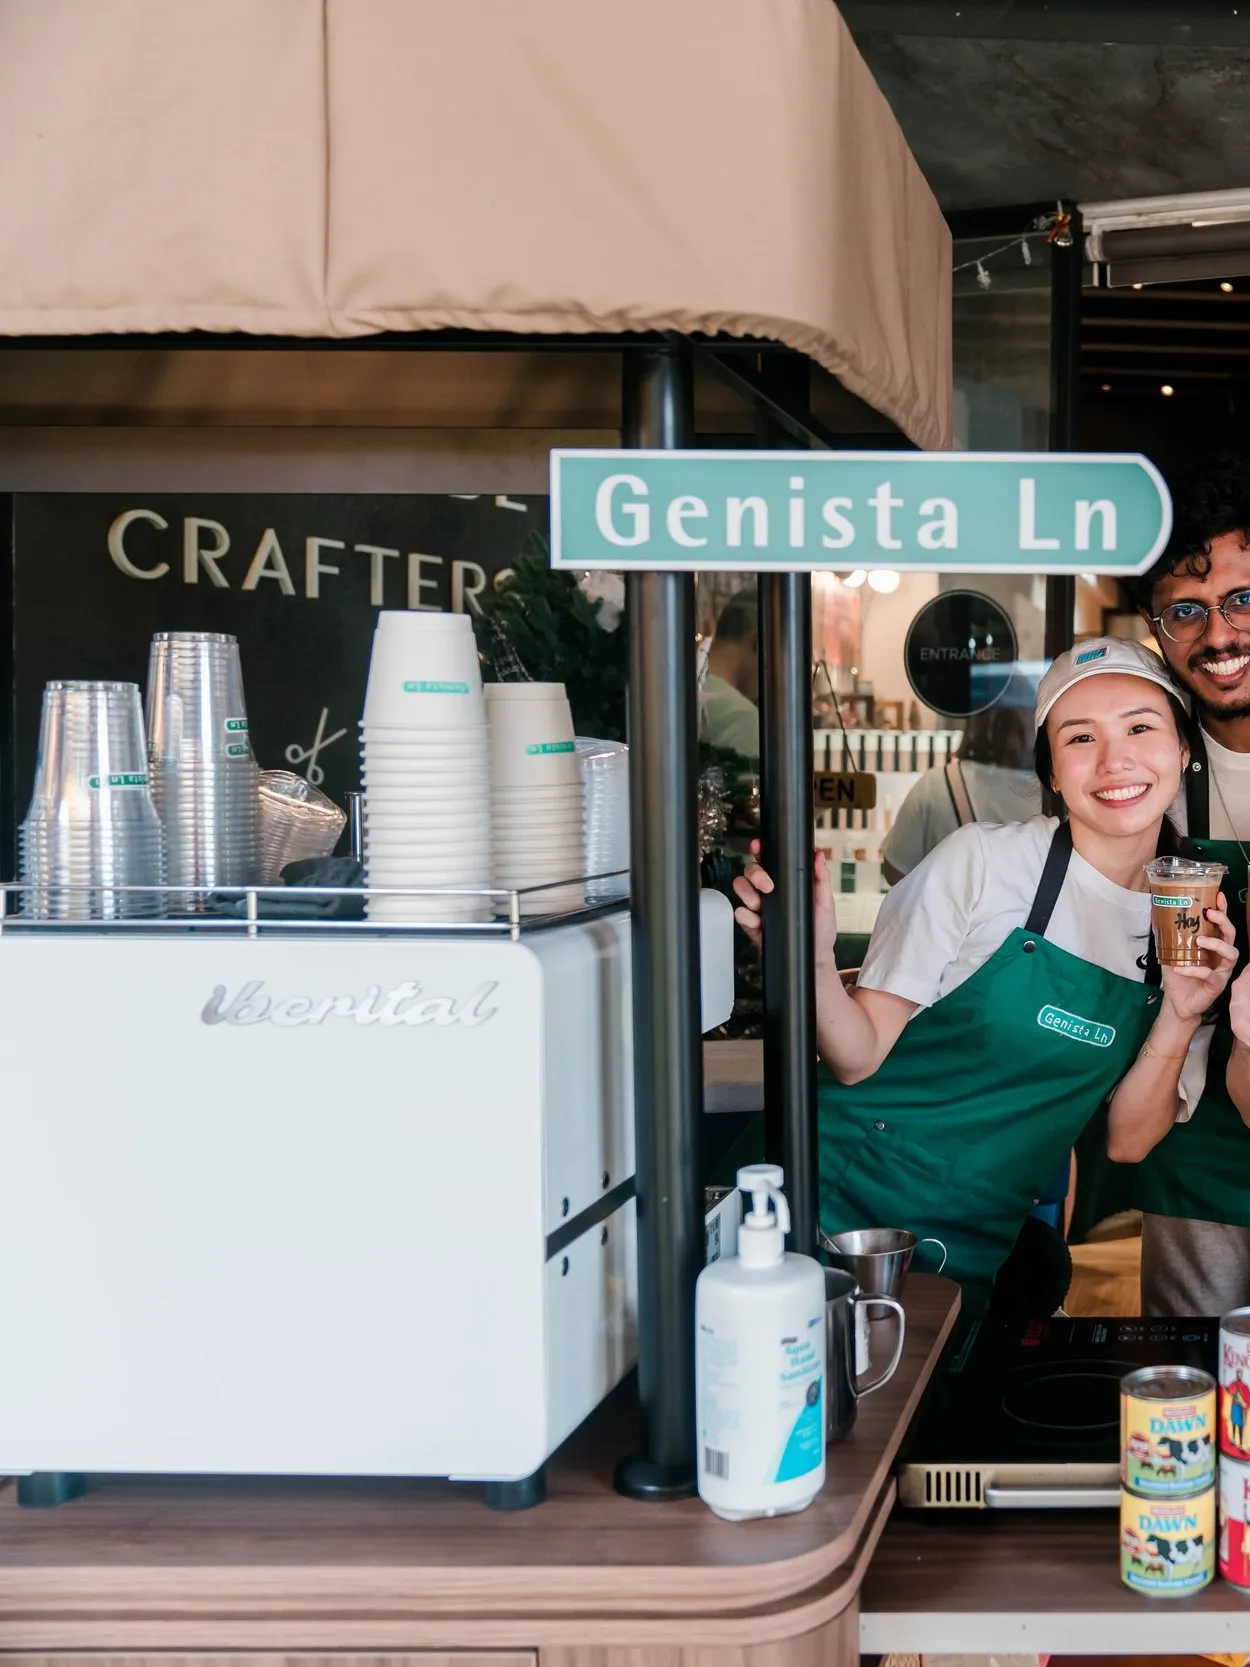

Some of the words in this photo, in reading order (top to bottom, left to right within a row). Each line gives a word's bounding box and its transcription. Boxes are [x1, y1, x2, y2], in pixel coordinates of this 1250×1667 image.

[595, 473, 959, 550] Genista
[1018, 477, 1118, 551] Ln
[920, 647, 1001, 661] ENTRANCE
[815, 778, 855, 802] EN
[1155, 897, 1177, 905] Genista
[200, 980, 500, 1027] iberital
[1044, 1012, 1090, 1037] Genista
[1094, 1027, 1108, 1044] Ln
[1150, 1413, 1207, 1435] DAWN
[1138, 1513, 1197, 1533] DAWN
